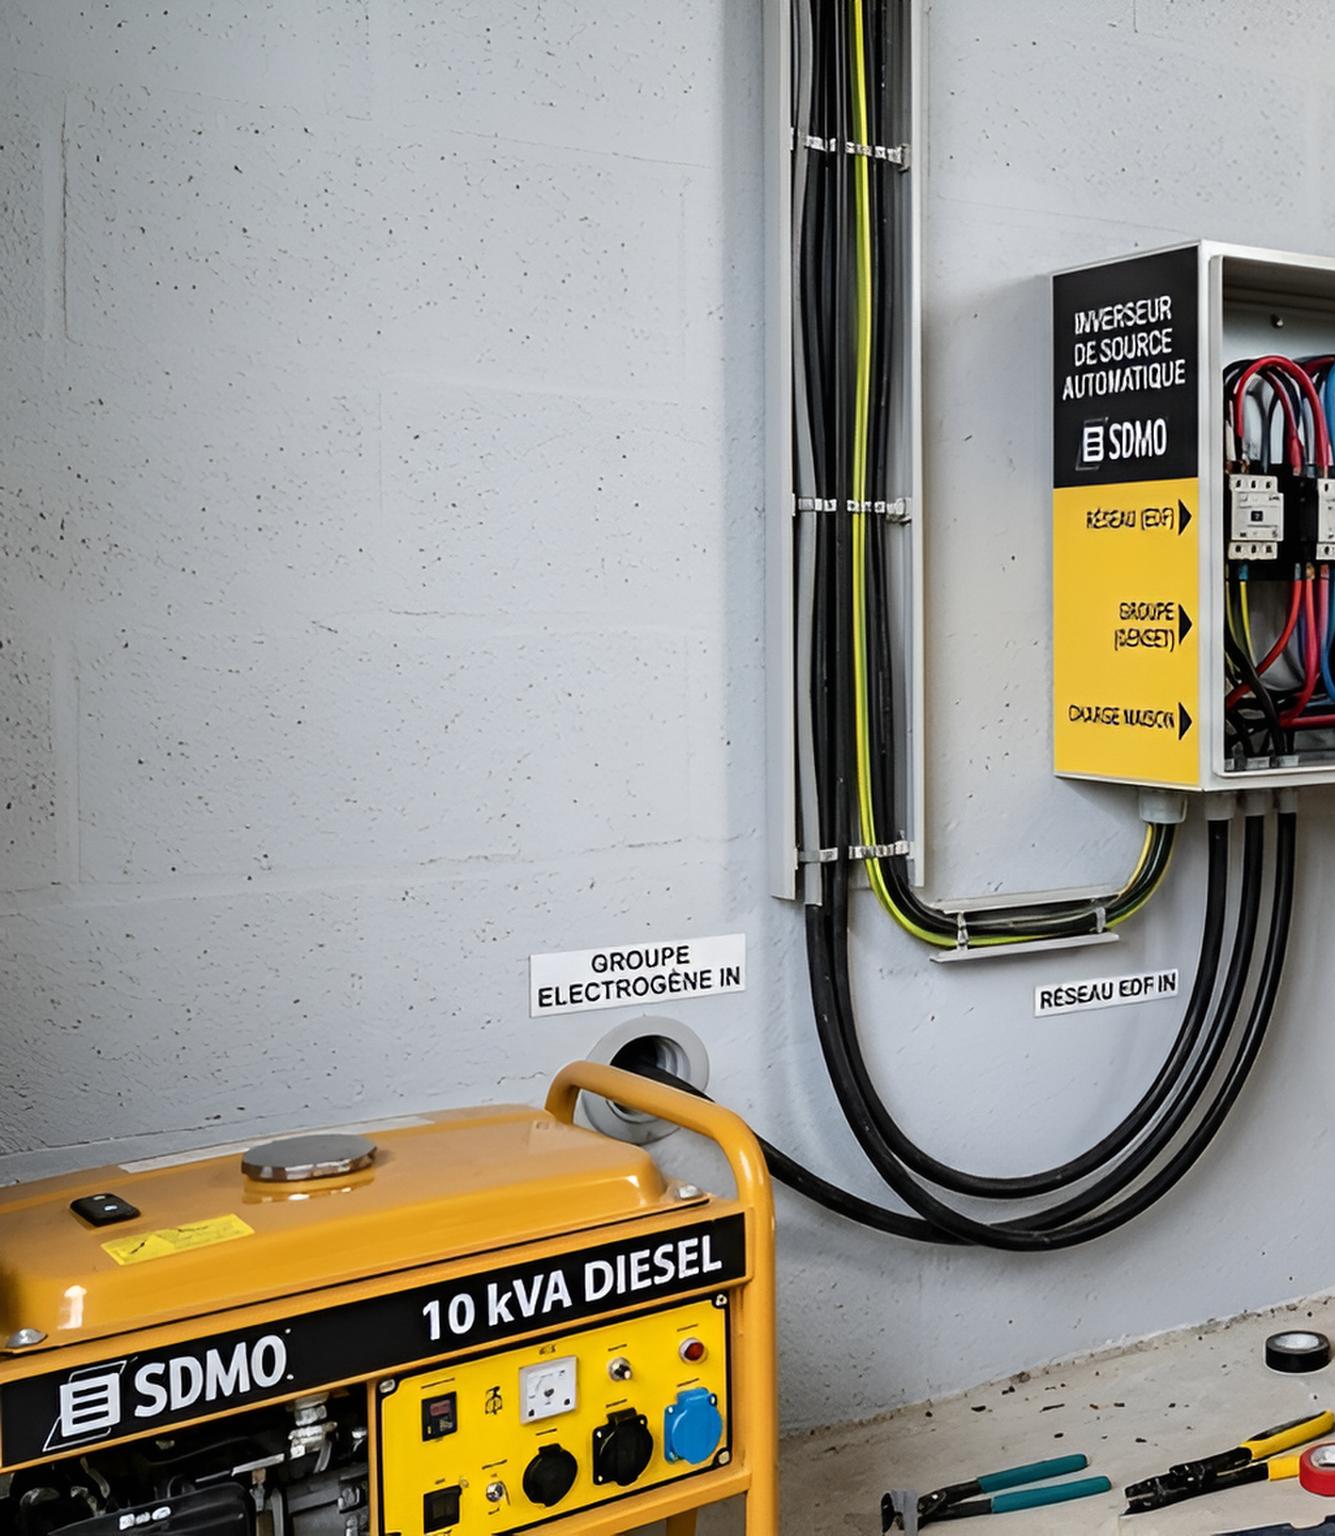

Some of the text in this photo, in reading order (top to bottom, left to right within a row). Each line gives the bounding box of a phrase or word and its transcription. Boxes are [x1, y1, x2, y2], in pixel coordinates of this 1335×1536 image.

[1075, 295, 1172, 335] INVERSEUR
[1075, 328, 1173, 367] DE SOURCE
[1062, 359, 1186, 401] AUTOMATIQUE
[1108, 417, 1168, 461] SDMO
[591, 945, 690, 973] GROUPE
[720, 966, 741, 988] IN
[1119, 976, 1154, 997] EDF
[1158, 972, 1176, 993] IN
[422, 1234, 723, 1341] 10 kVA DIESEL
[134, 1333, 288, 1418] SDMO
